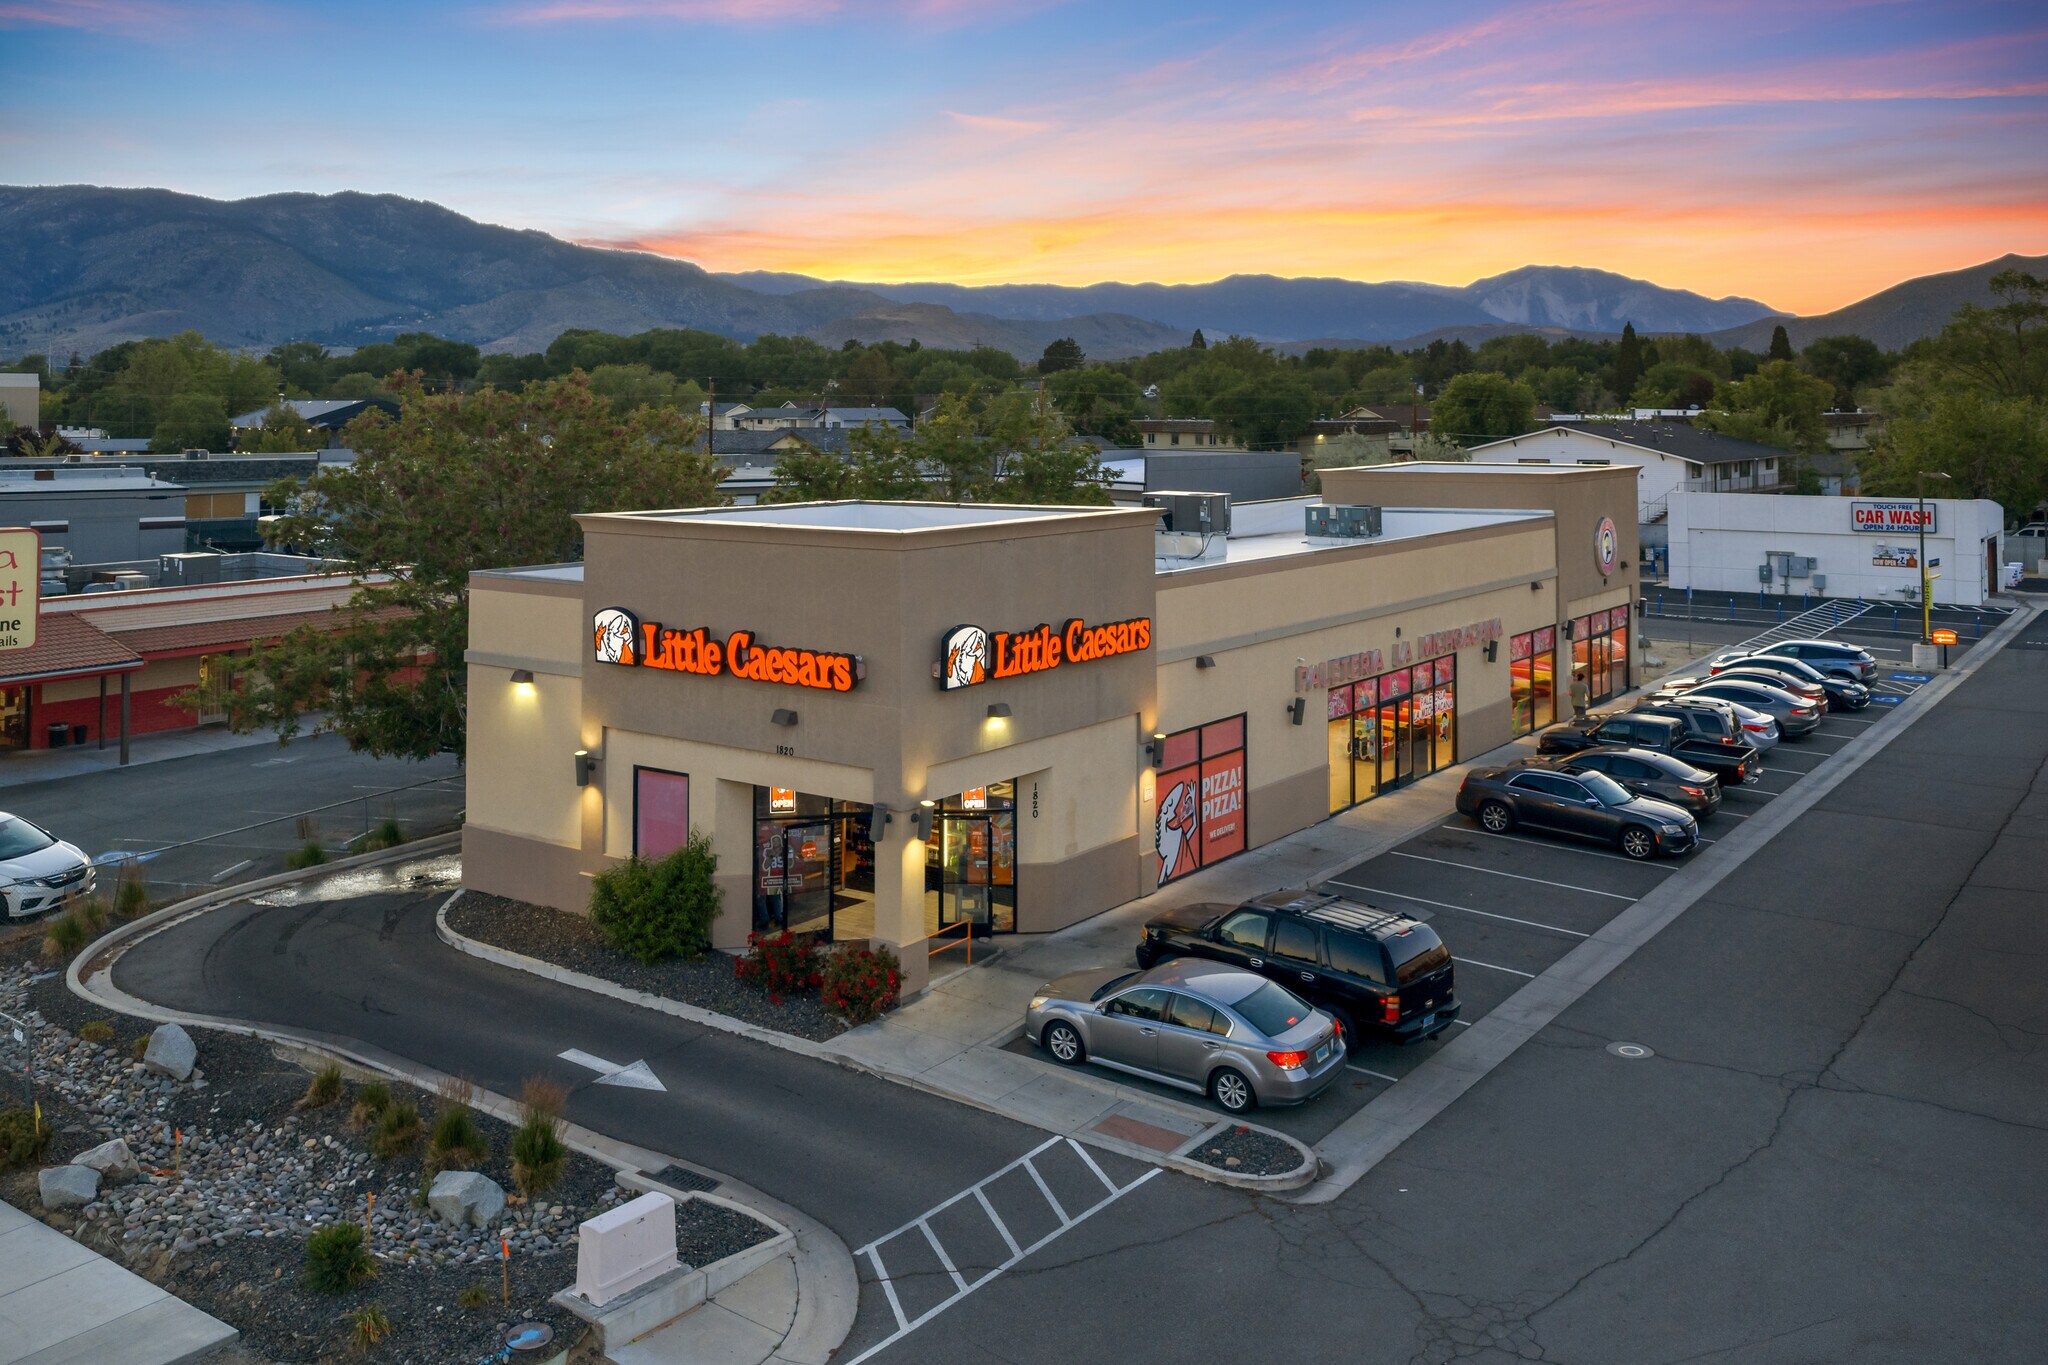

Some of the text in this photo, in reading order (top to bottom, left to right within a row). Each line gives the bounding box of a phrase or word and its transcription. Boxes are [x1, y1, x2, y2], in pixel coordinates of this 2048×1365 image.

[1855, 509, 1931, 525] CAR WASH
[641, 623, 854, 692] Little Caesars
[993, 618, 1151, 680] Little Caesars
[1295, 618, 1503, 692] PALETERIA LA MICHOACANA
[1420, 689, 1446, 706] PALEERIA
[776, 745, 794, 756] 1820
[1202, 766, 1242, 799] PIZZA!
[772, 799, 794, 808] OPEN
[964, 799, 984, 808] OPEN
[1202, 789, 1242, 823] PIZZA!
